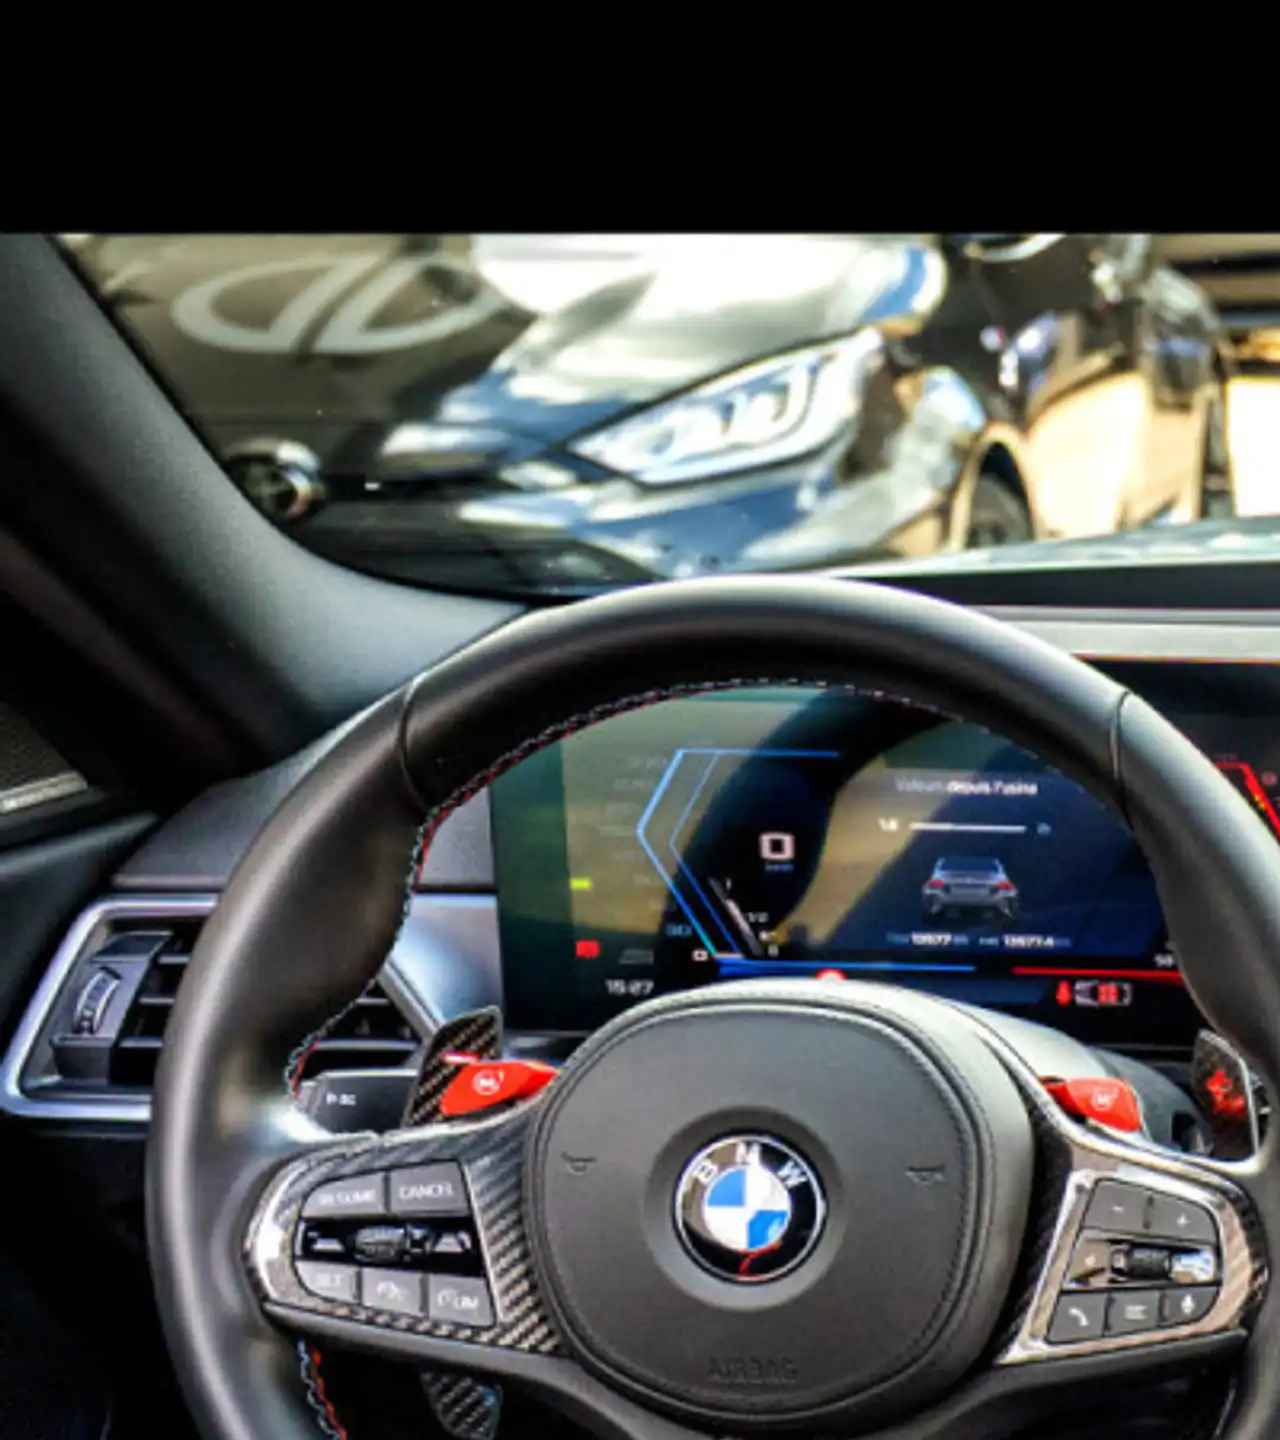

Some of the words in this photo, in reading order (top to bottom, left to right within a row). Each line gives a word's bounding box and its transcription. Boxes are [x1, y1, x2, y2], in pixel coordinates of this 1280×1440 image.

[760, 832, 795, 860] 0
[694, 1141, 808, 1187] BMW
[400, 1182, 454, 1201] CANCEL
